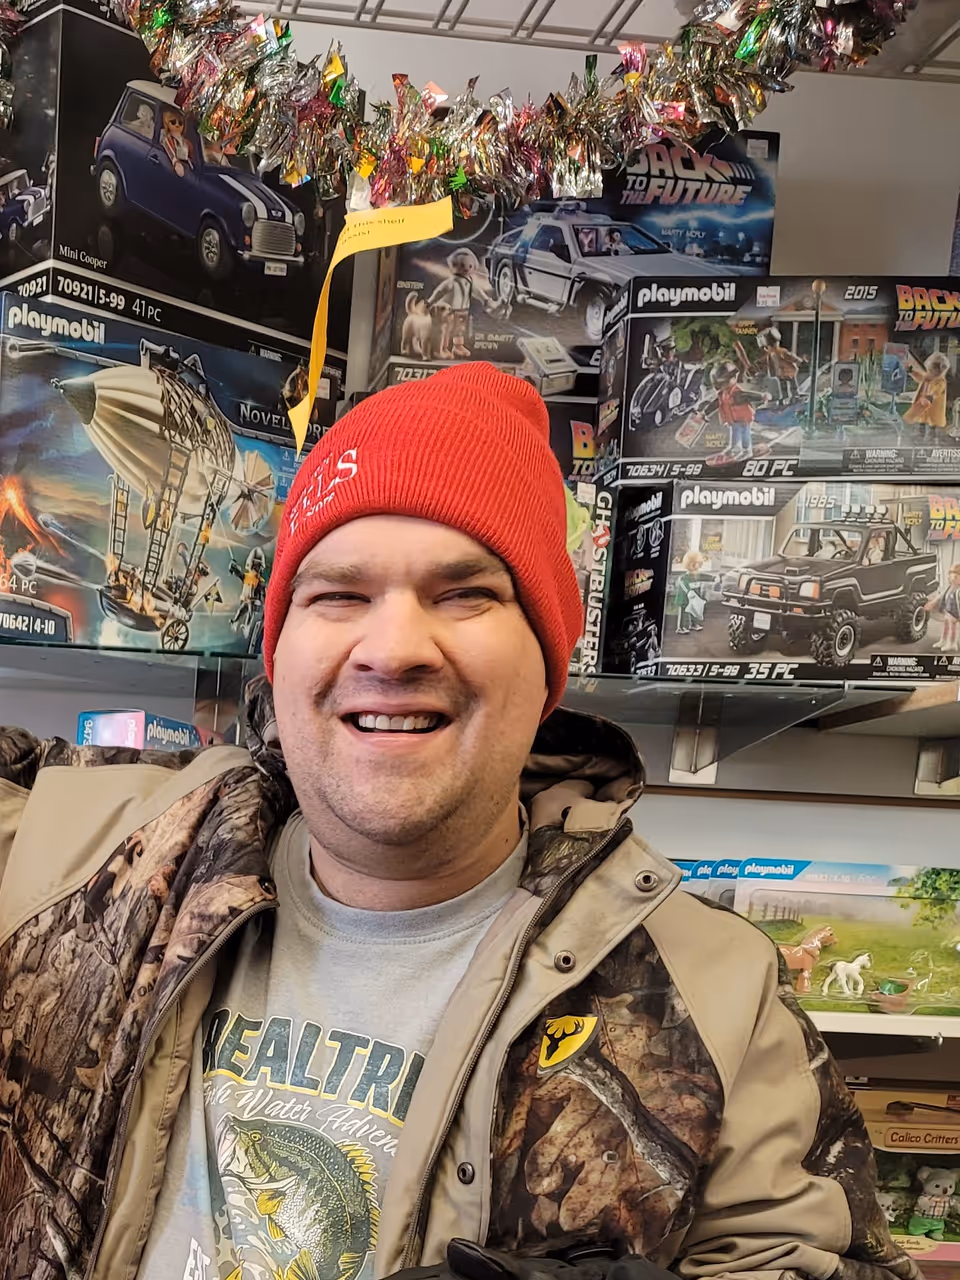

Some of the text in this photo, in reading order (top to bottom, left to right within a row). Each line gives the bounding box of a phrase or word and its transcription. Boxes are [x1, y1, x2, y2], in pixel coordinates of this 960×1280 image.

[626, 175, 647, 190] TO
[648, 178, 752, 205] FUTURE
[59, 244, 108, 270] Mini Cooper
[17, 275, 46, 297] 70921
[637, 282, 736, 307] playmobil
[844, 285, 878, 299] 2015
[57, 276, 162, 322] 70921 5-99 41 PC
[8, 303, 106, 345] playmobil
[742, 460, 768, 477] 80
[770, 460, 797, 477] PC
[680, 485, 775, 509] playmobil
[805, 495, 836, 508] 1985
[0, 573, 37, 594] 64 PC
[34, 617, 56, 636] 4-10
[744, 663, 771, 678] 35
[772, 663, 799, 679] PC
[147, 719, 189, 745] playmobil
[744, 860, 794, 878] playmobil
[236, 1089, 312, 1122] Water
[890, 1132, 959, 1145] Calico Critters
